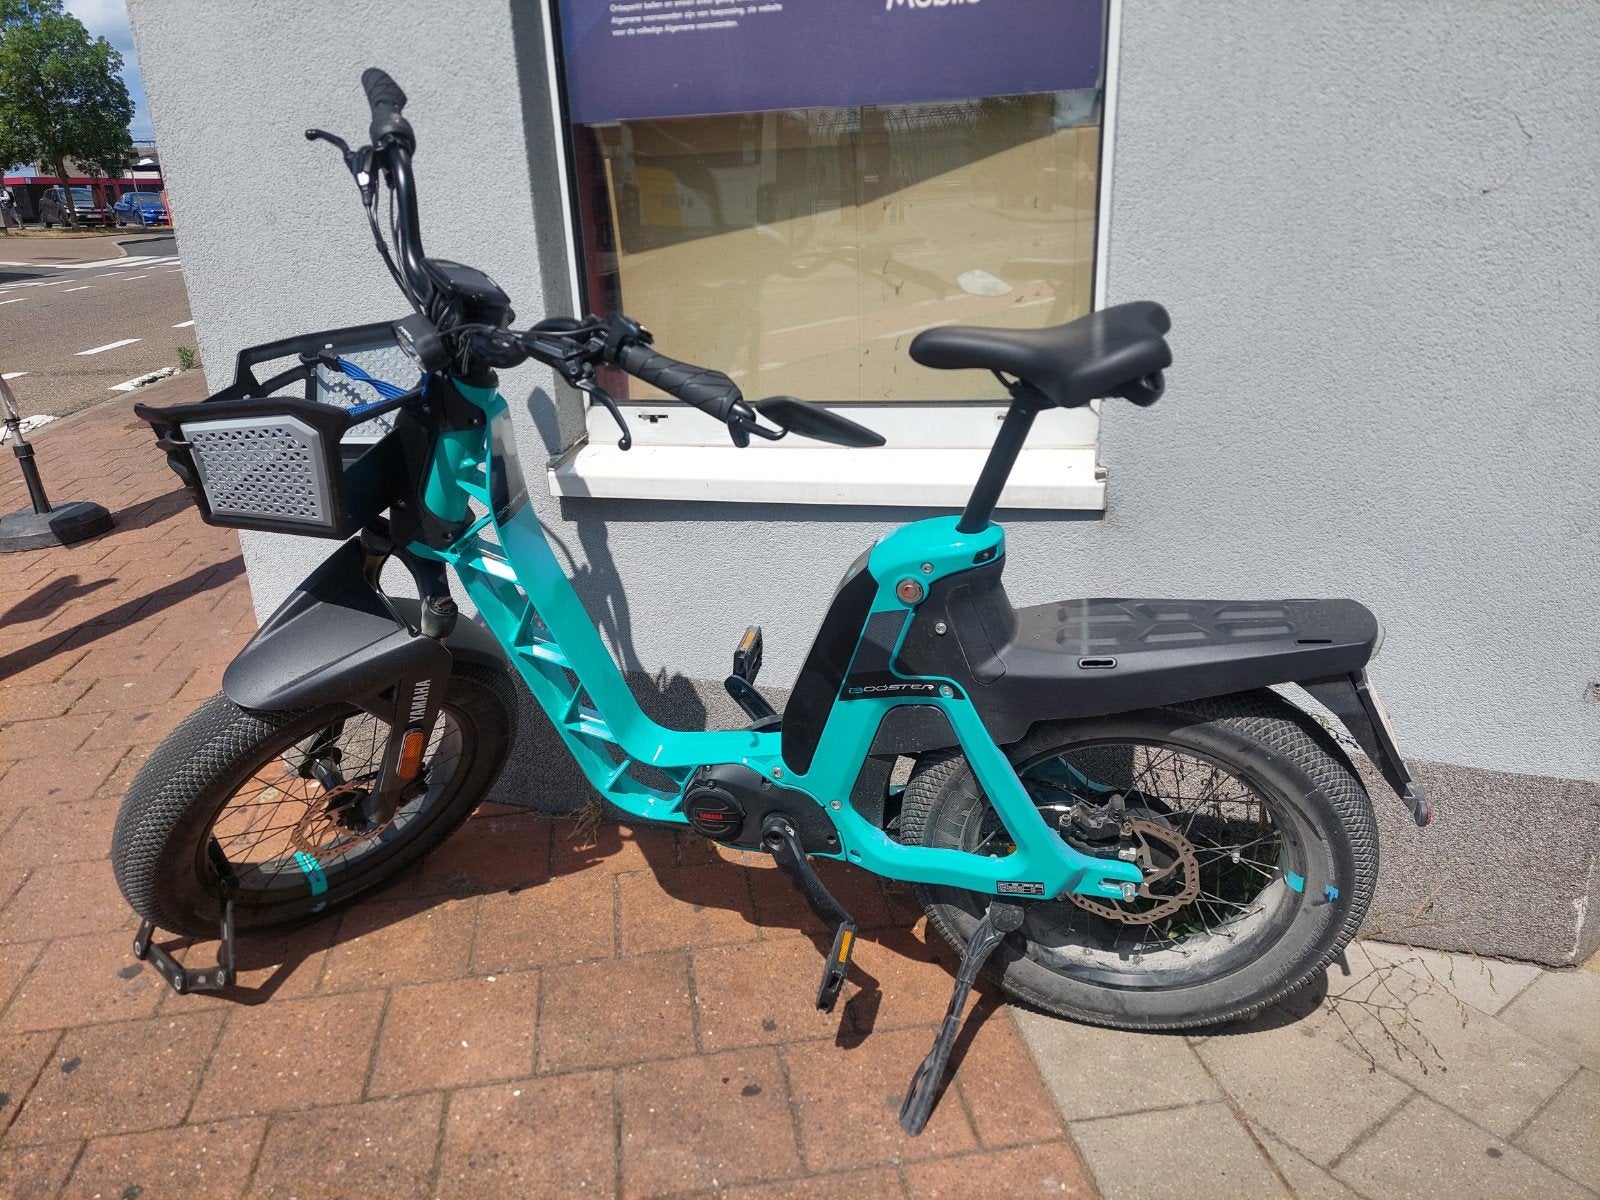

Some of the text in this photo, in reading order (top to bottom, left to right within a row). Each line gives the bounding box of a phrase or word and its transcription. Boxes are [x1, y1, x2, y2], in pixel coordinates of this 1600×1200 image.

[848, 683, 935, 695] BOOSTER
[408, 679, 432, 723] YAMAHA
[698, 811, 724, 821] YAMAHA
